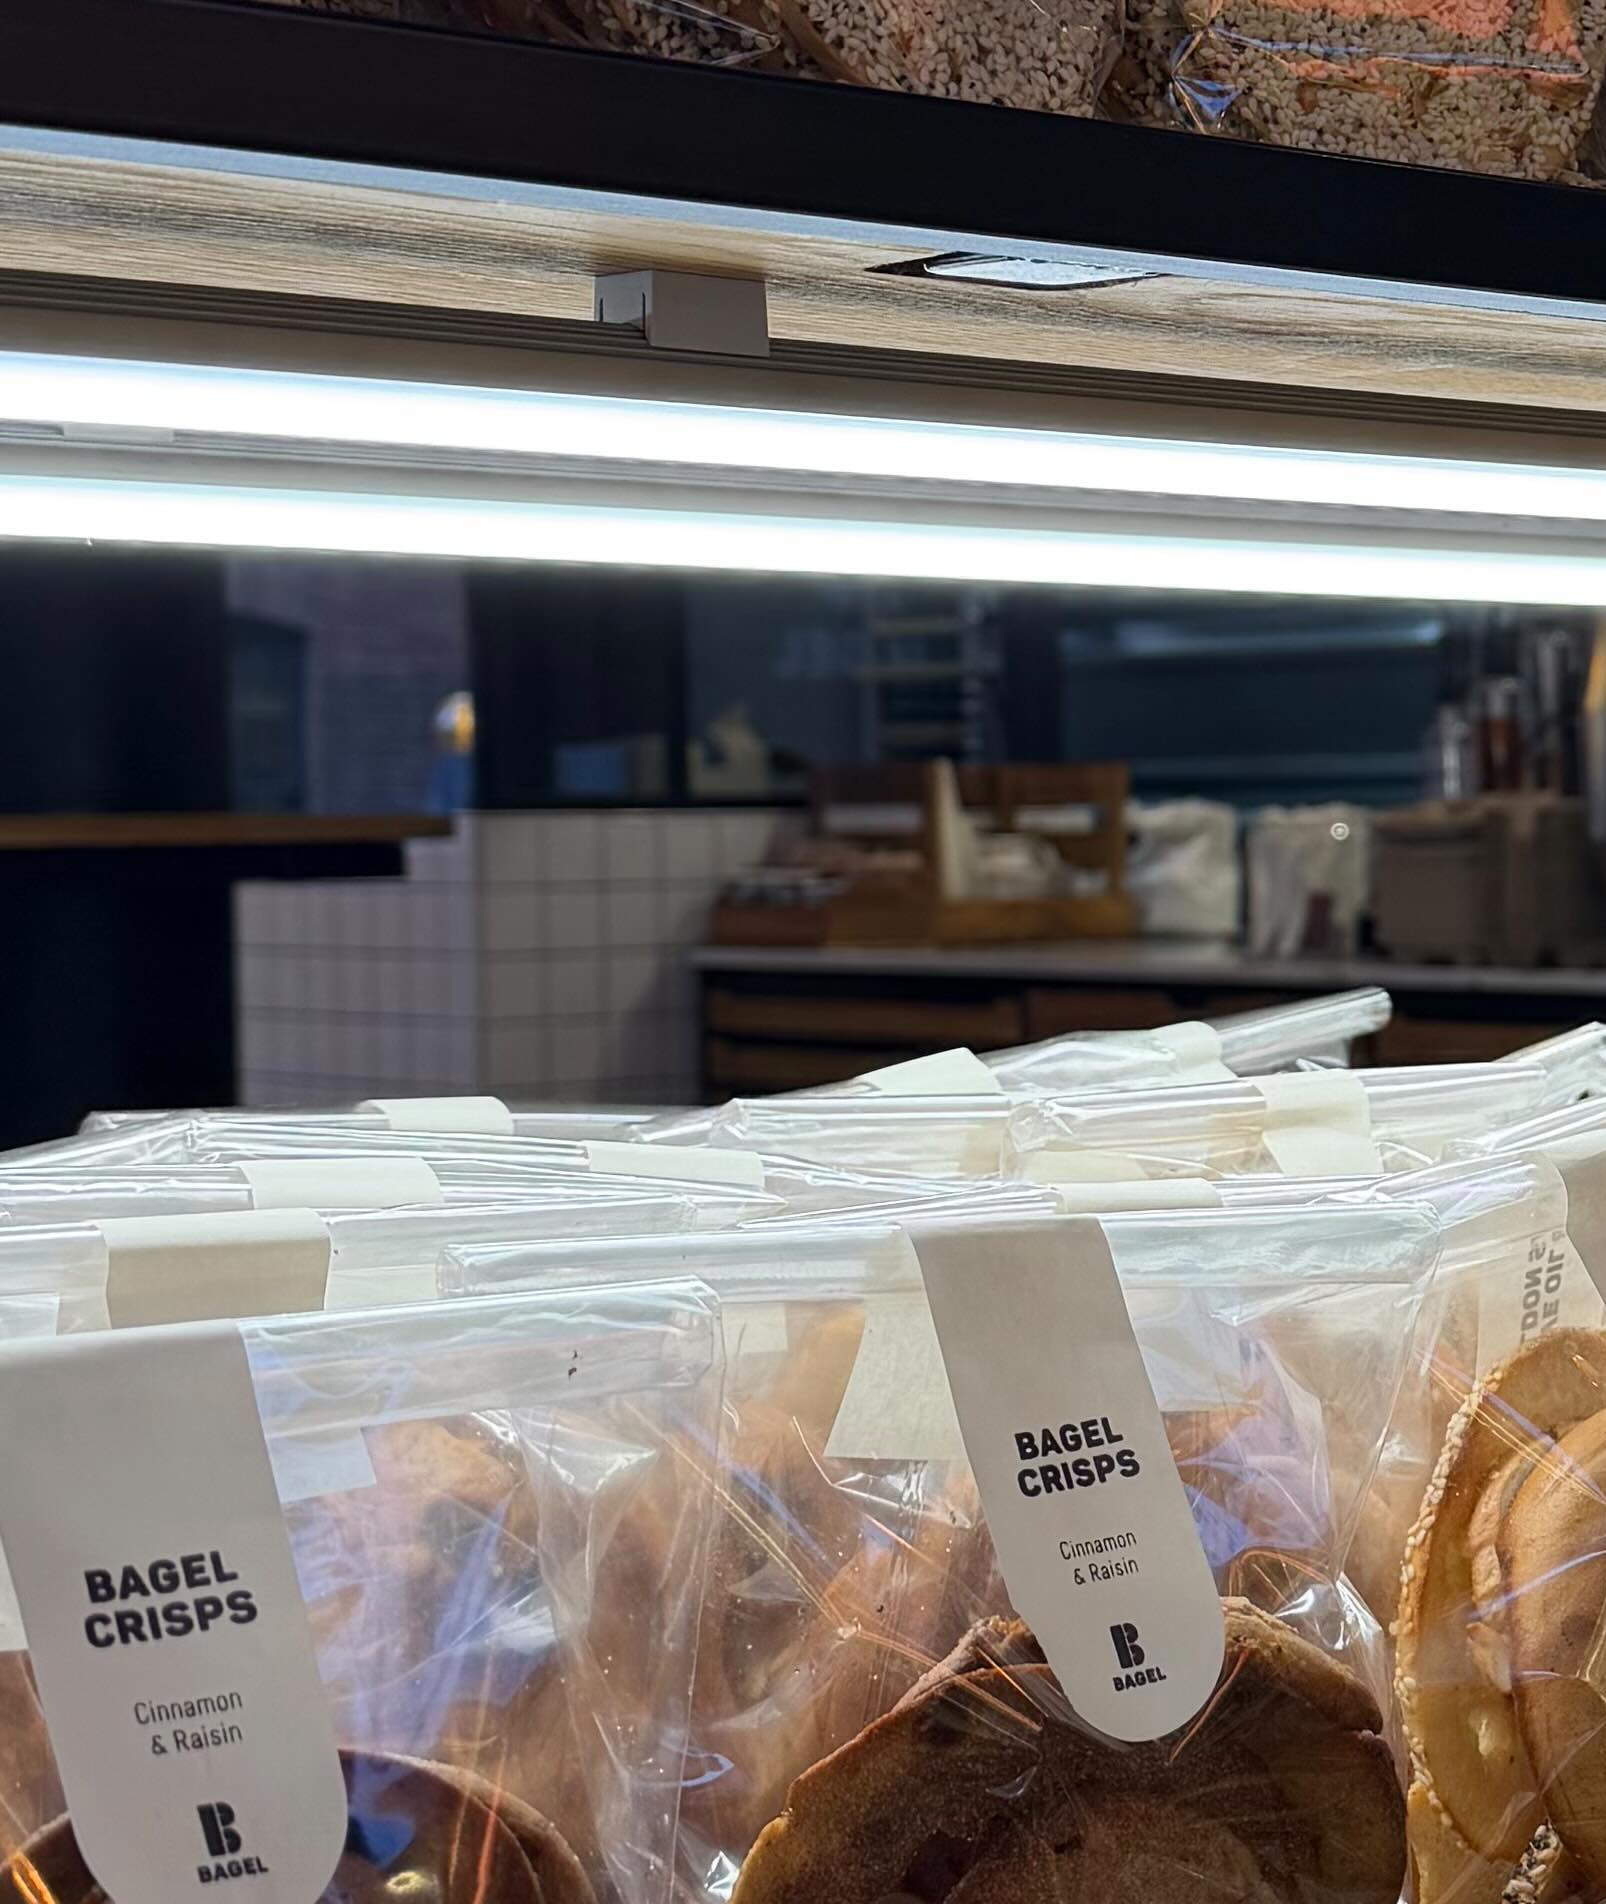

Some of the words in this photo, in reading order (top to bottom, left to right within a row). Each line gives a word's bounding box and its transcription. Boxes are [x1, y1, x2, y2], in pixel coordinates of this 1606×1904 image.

[1014, 1417, 1124, 1461] BAGEL
[1017, 1449, 1140, 1497] CRISPS
[1059, 1531, 1137, 1561] Cinnamon
[84, 1551, 239, 1604] BAGEL
[1073, 1568, 1087, 1586] &
[1088, 1556, 1140, 1583] Raisin
[84, 1590, 258, 1648] CRISPS
[1112, 1666, 1167, 1692] BAGEL
[133, 1691, 243, 1725] Cinnamon
[151, 1734, 168, 1756] &
[172, 1723, 243, 1752] Raisin
[197, 1856, 269, 1884] BAGEL
